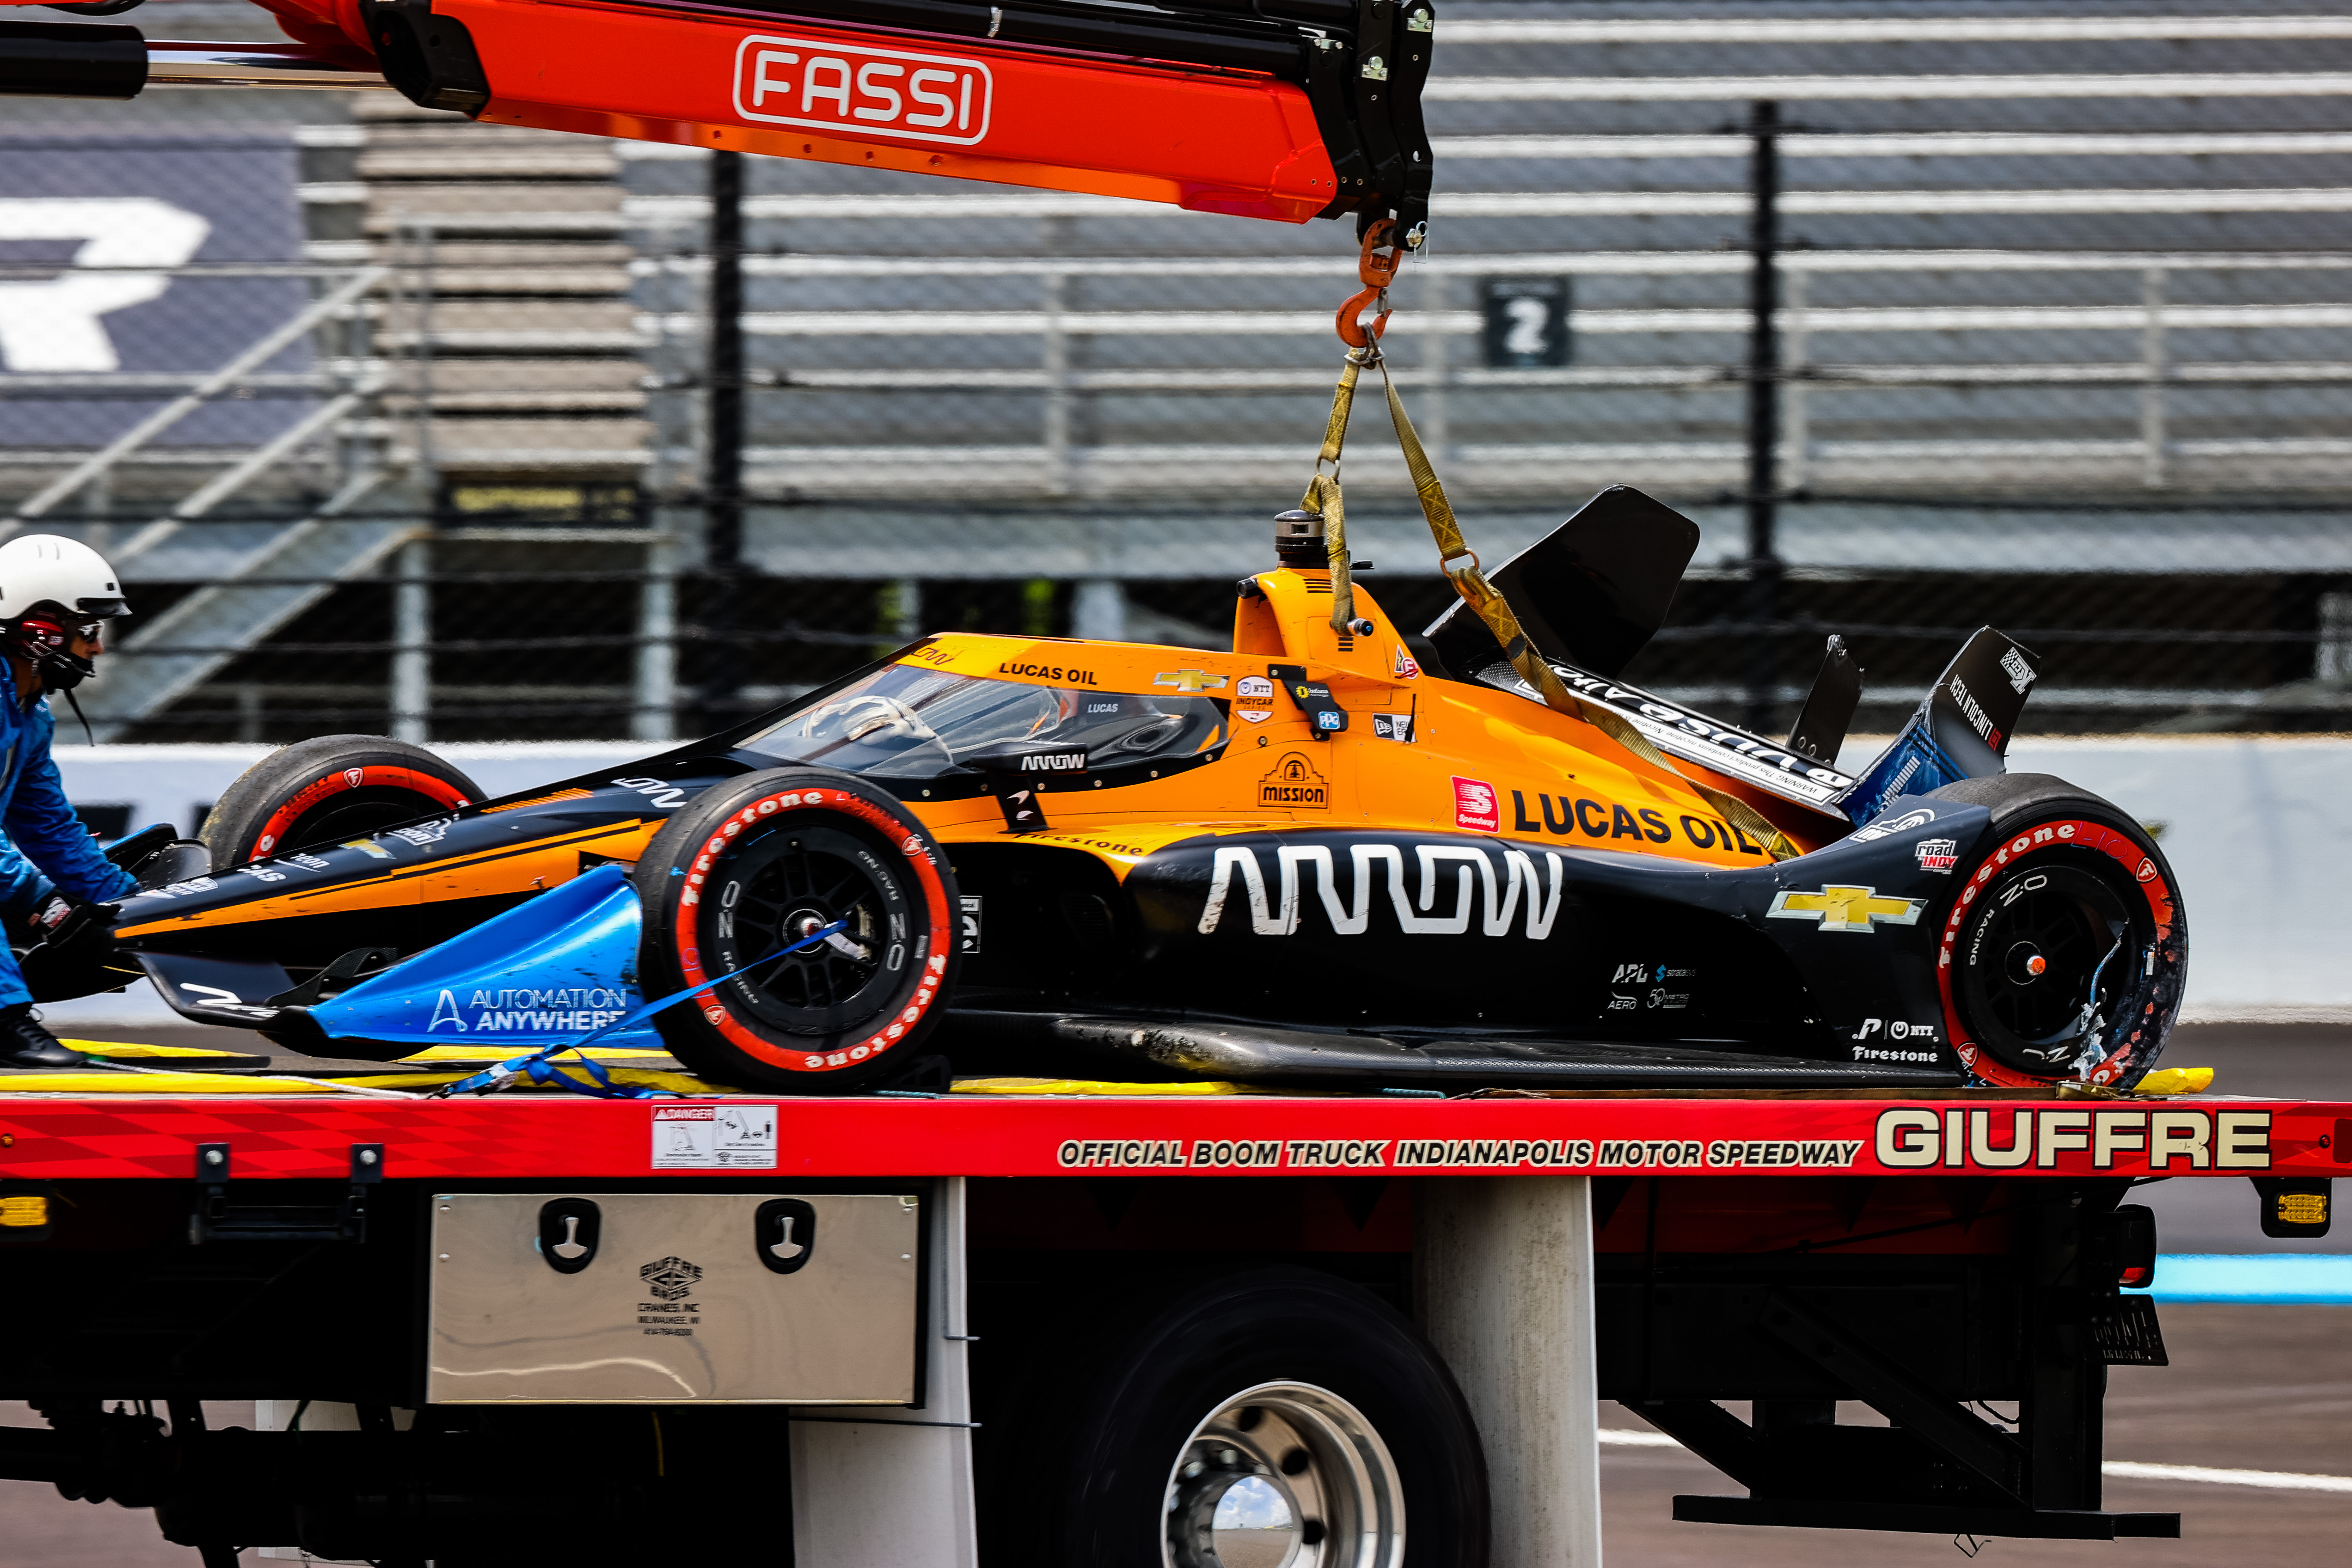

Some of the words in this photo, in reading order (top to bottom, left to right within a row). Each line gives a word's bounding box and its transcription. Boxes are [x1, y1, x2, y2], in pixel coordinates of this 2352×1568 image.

[753, 49, 972, 131] FASSI
[1504, 297, 1550, 353] 2
[998, 662, 1063, 680] LUCAS
[1067, 669, 1098, 685] OIL
[1949, 674, 1966, 708] TECH
[1087, 704, 1118, 714] LUCAS
[1236, 698, 1274, 706] INDYCAR
[1320, 713, 1338, 727] PPG
[1632, 719, 1664, 733] Nicotine
[1964, 695, 1994, 742] LINCOLN
[1697, 744, 1730, 758] contains
[1021, 754, 1085, 771] ARROW
[1730, 754, 1761, 771] product
[1758, 768, 1775, 777] This
[1263, 786, 1324, 803] mission
[1458, 814, 1497, 830] Speedway
[1513, 790, 1671, 844] LUCAS
[680, 790, 824, 907] Firestone
[1917, 842, 1954, 856] road
[1923, 856, 1956, 867] INDY
[1197, 844, 1563, 940] ARROW
[1938, 824, 2076, 969] Firestone
[1969, 909, 1994, 966] RACING
[1611, 964, 1648, 983] APL
[468, 988, 626, 1009] AUTOMATION
[1608, 1001, 1637, 1010] AERO
[804, 954, 946, 1069] Firestone
[1910, 1025, 1934, 1036] NTT
[1852, 1046, 1938, 1062] Firestone
[666, 1109, 714, 1120] DANGER
[1876, 1108, 2272, 1170] GIUFFRE
[1057, 1139, 1188, 1167] OFFICIAL
[1189, 1140, 1283, 1167] BOOM
[1285, 1140, 1391, 1167] TRUCK
[1393, 1140, 1594, 1167] INDIANAPOLIS
[1596, 1140, 1703, 1167] MOTOR
[1707, 1140, 1865, 1167] SPEEDWAY
[640, 1256, 703, 1279] GIUFFRE
